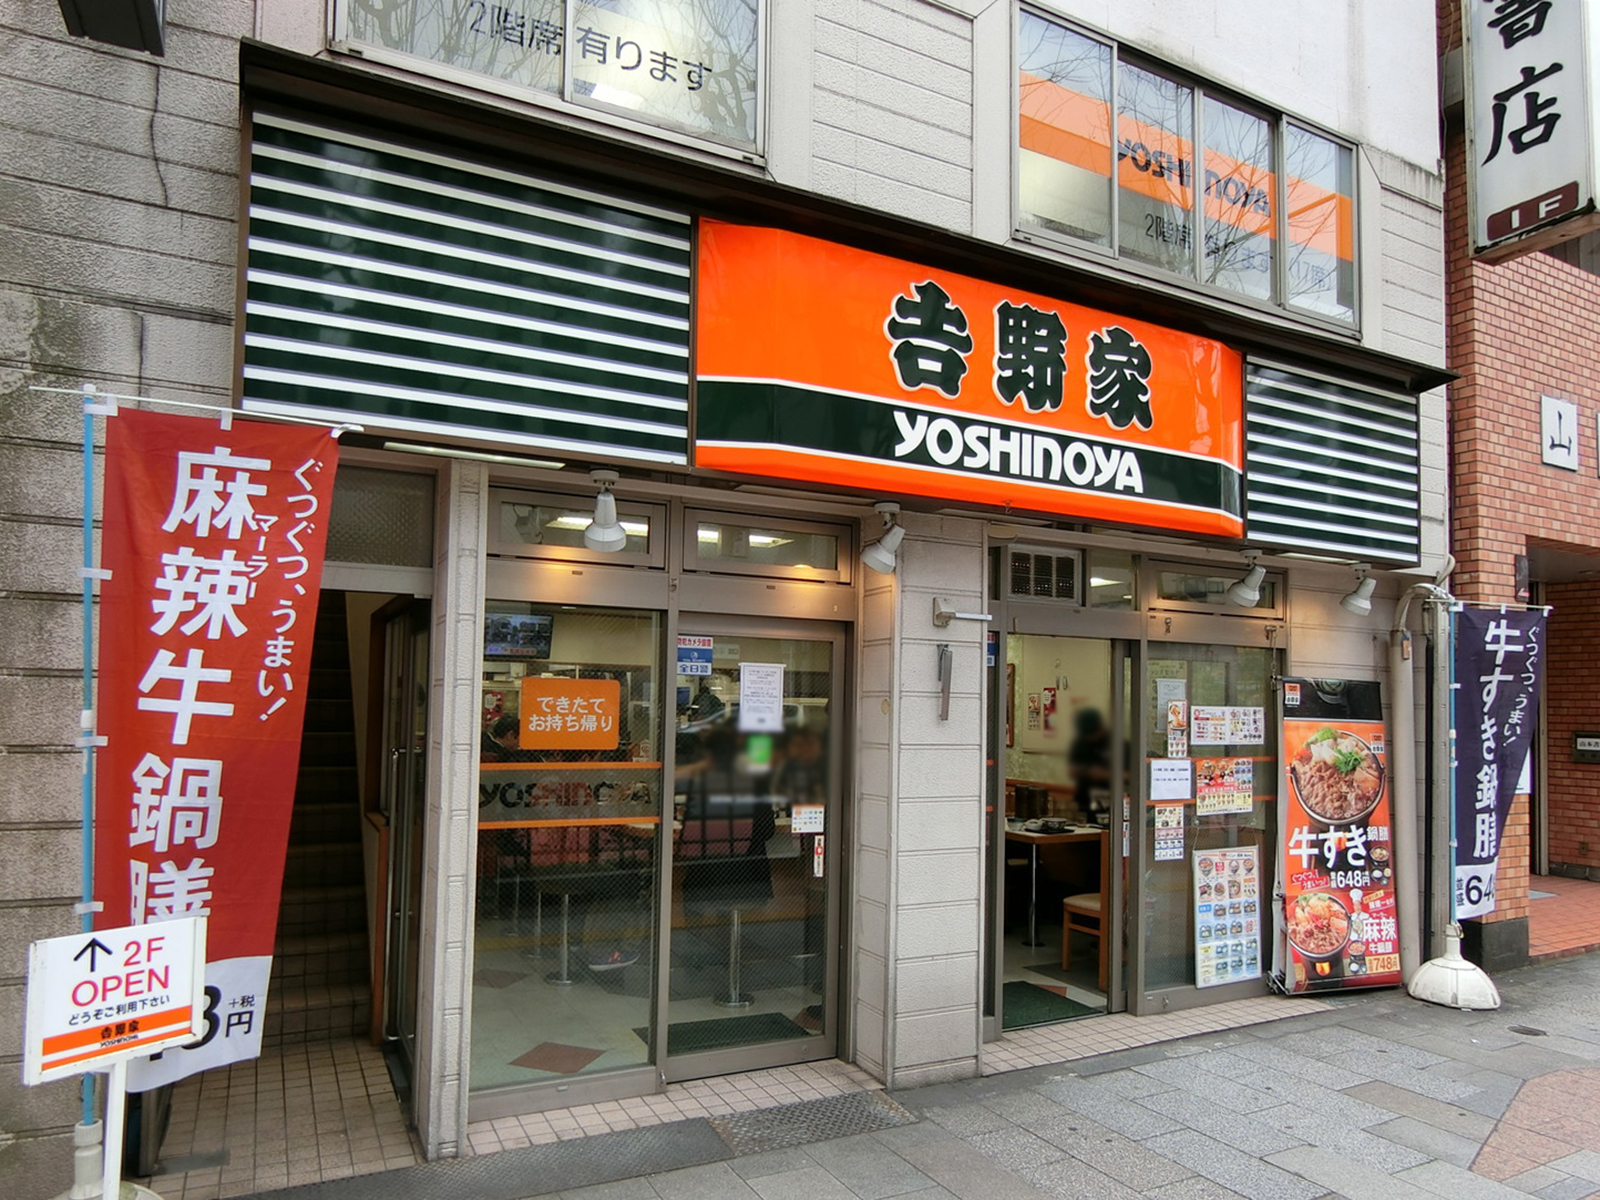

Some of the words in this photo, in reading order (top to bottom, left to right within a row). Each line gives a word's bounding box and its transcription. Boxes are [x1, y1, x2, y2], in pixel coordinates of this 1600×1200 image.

[576, 27, 712, 91] 有ります
[884, 280, 1153, 432] 吉野家
[893, 410, 1144, 494] YOSHINOYA
[1549, 410, 1573, 457] 山
[246, 513, 279, 599] マーラー
[528, 713, 613, 733] お持ち帰り
[536, 696, 606, 714] できたて
[1288, 824, 1368, 870] 牛すき
[123, 936, 166, 967] 2F
[71, 965, 170, 1007] OPEN
[68, 995, 171, 1027] どうぞご利用下さい
[225, 1010, 254, 1038] 円
